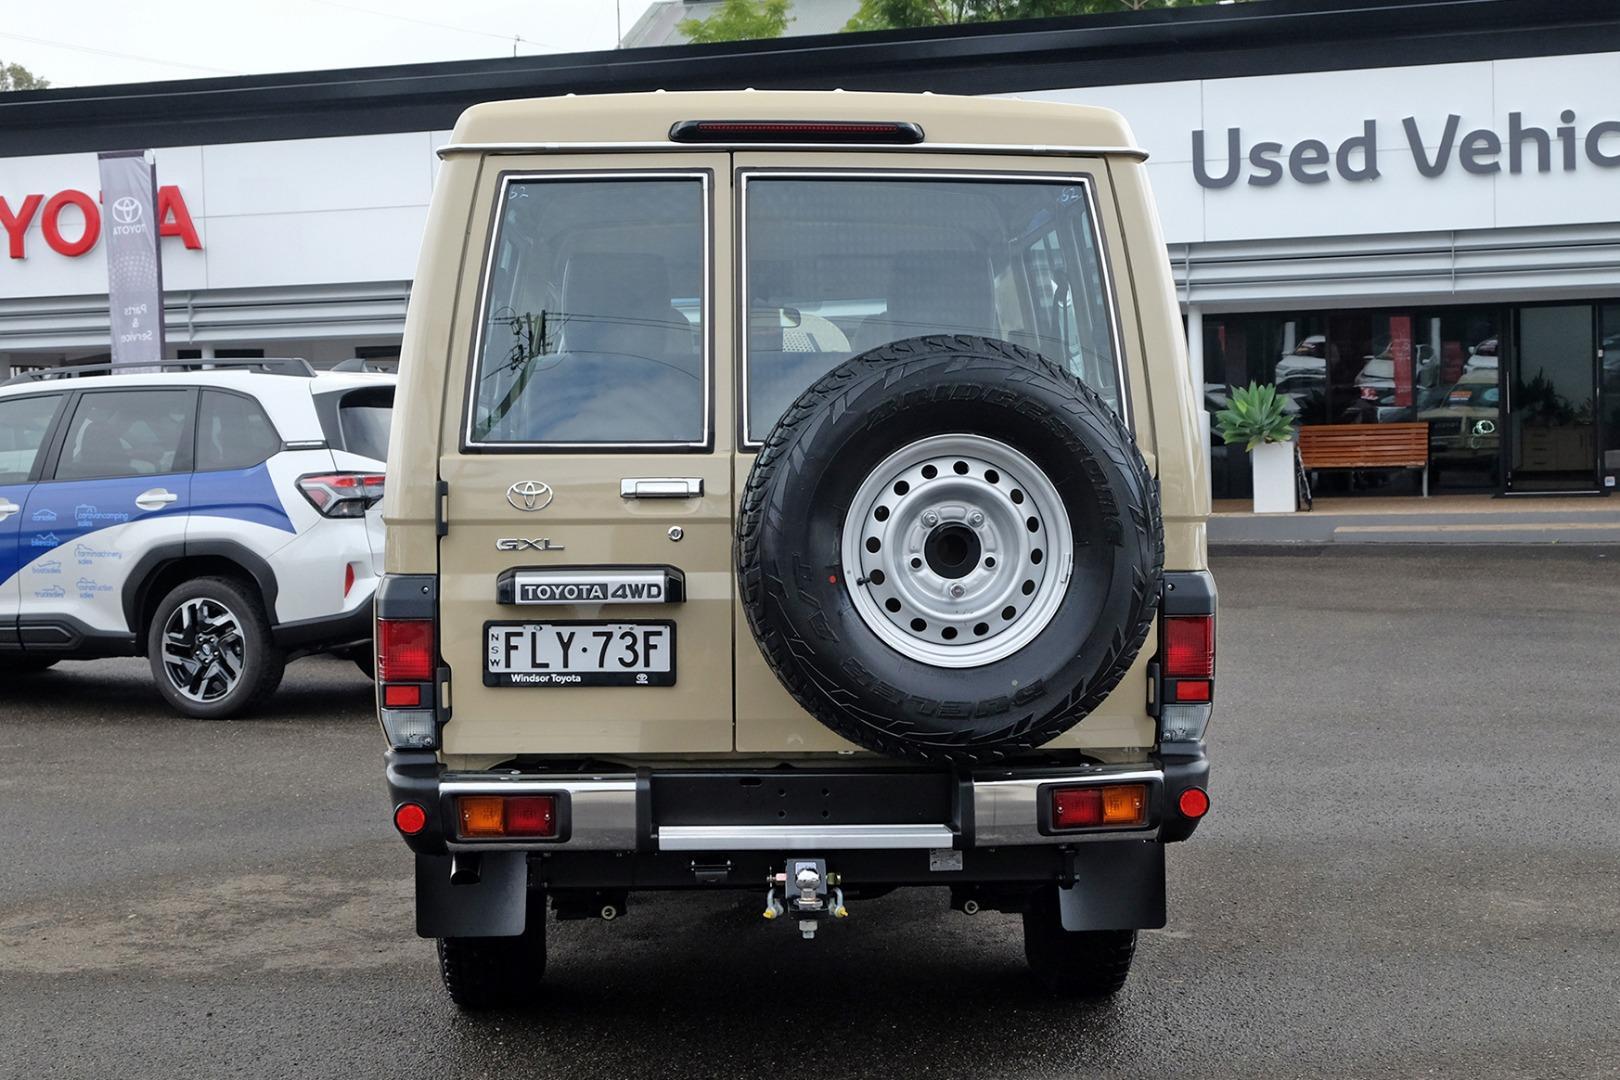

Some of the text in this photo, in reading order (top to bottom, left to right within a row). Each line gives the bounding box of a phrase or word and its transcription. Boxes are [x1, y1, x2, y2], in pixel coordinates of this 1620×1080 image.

[1191, 109, 1620, 189] Used Vehic
[0, 185, 204, 260] YOA
[496, 538, 565, 551] GXL
[525, 583, 662, 600] TOYOTA 4WD
[511, 673, 581, 684] Windsor Toyota
